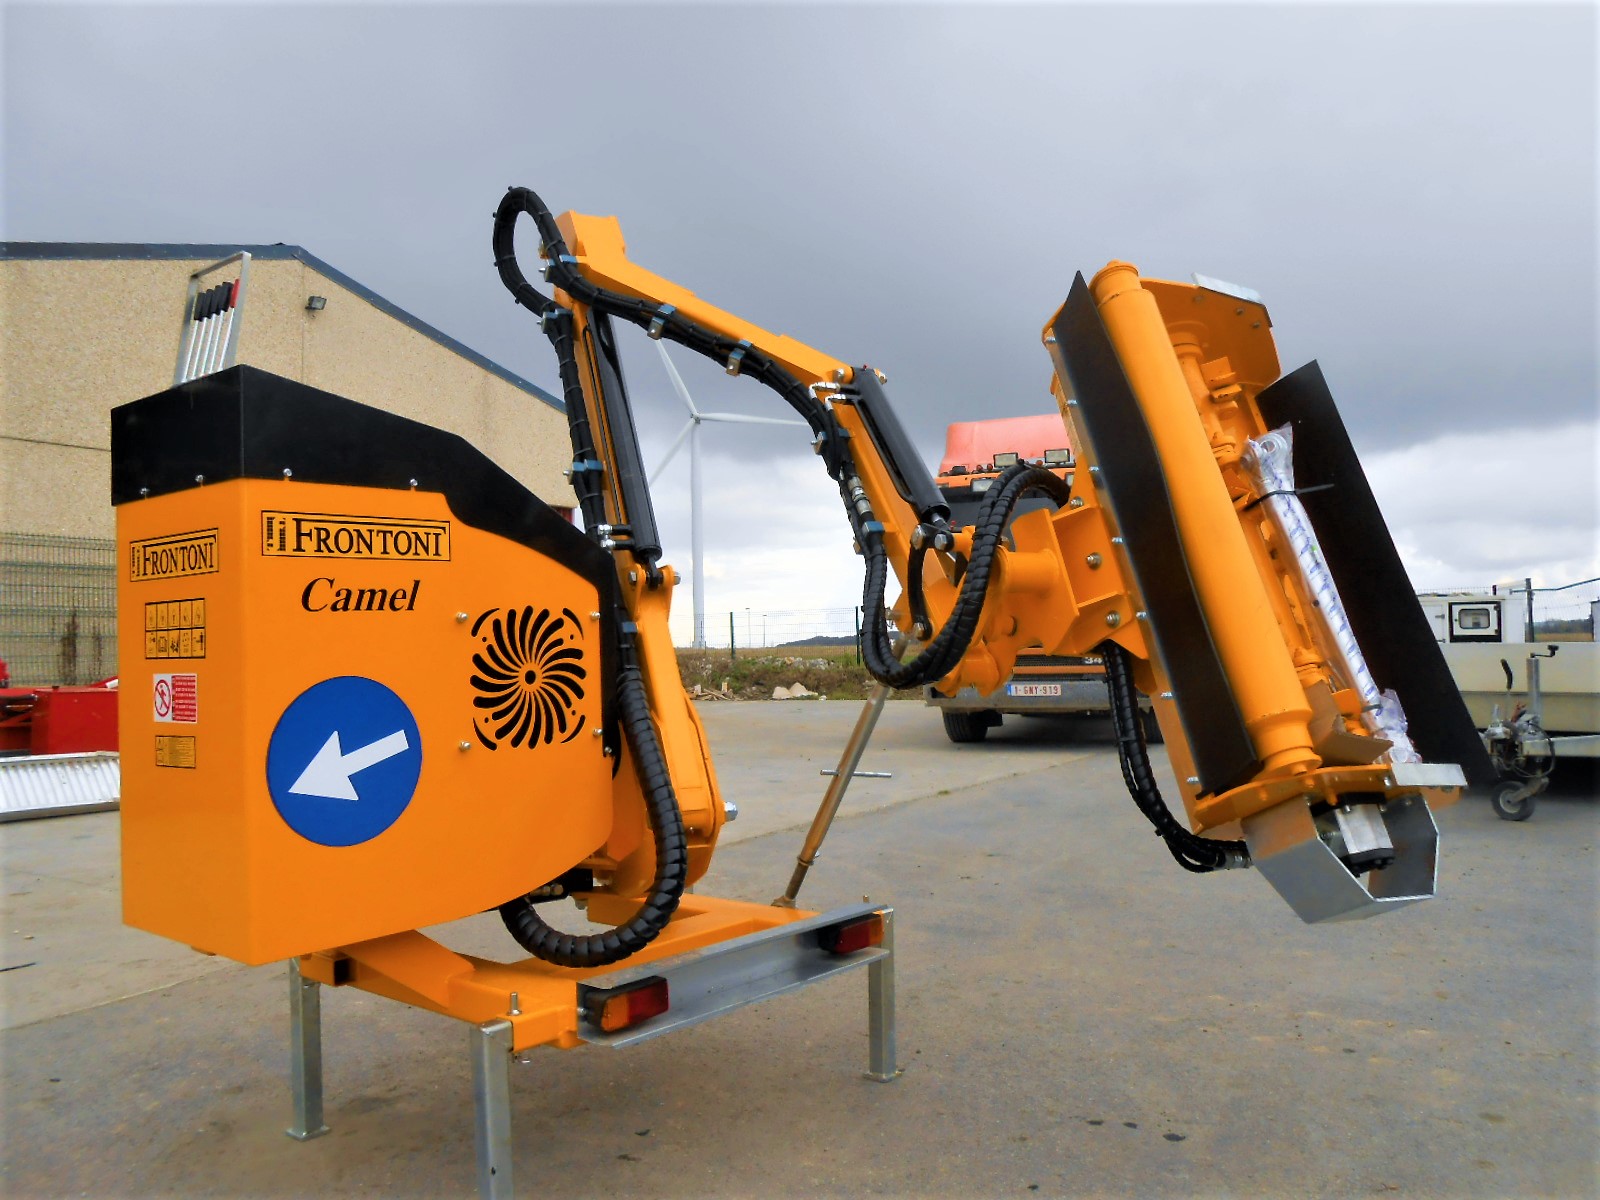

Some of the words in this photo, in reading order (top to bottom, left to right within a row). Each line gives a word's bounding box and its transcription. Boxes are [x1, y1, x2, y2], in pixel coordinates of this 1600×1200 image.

[142, 534, 217, 576] FRONTONI
[292, 517, 447, 557] FRONTONI
[301, 577, 421, 612] Camel
